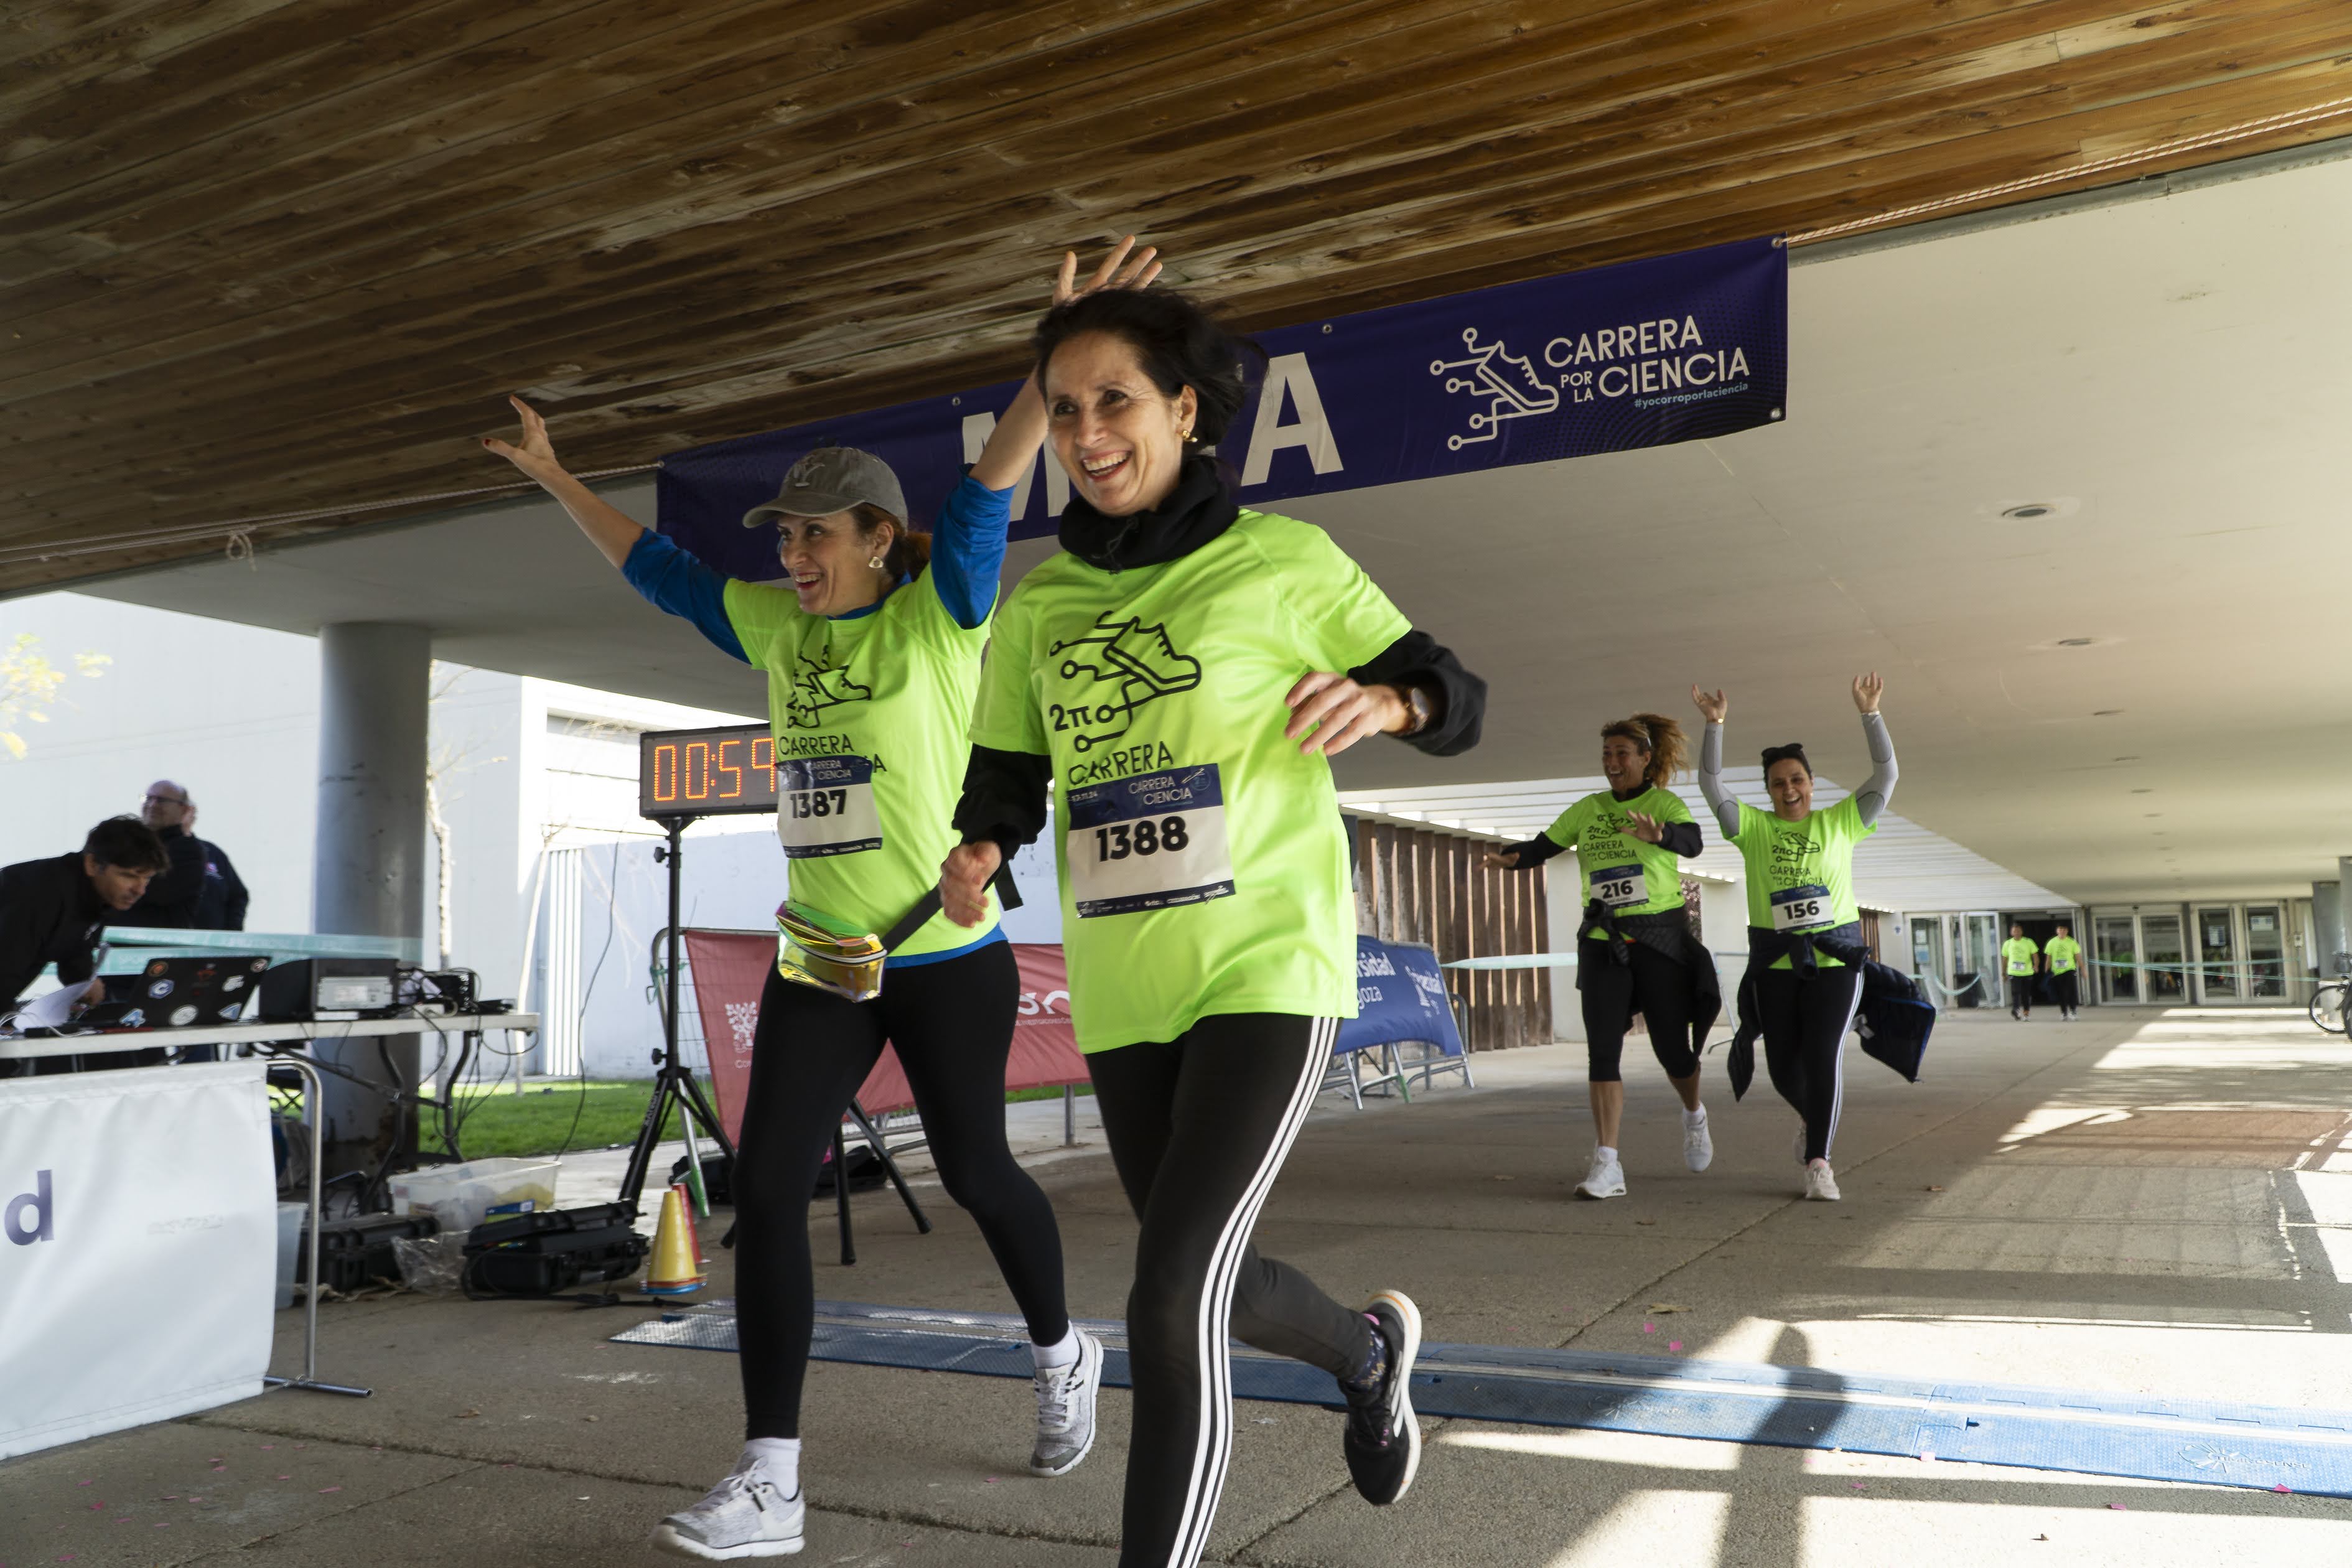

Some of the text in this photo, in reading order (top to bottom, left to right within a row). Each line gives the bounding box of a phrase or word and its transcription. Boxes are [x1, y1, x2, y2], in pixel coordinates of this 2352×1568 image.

[1544, 315, 1703, 368] CARRERA
[1561, 347, 1750, 398] POR CIENCIA
[1574, 387, 1594, 403] LA
[1634, 381, 1748, 409] #yocorroporlaciencia
[963, 352, 1344, 522] MA
[778, 734, 855, 755] CARRERA
[1068, 740, 1174, 786] CARRERA
[1128, 776, 1176, 795] CARRERA
[789, 788, 847, 819] 1387
[1142, 787, 1194, 805] CIENCIA
[1096, 815, 1189, 862] 1388
[1583, 840, 1625, 852] CARRERA
[1597, 849, 1638, 861] CIENCIA
[1769, 865, 1812, 878] CARRERA
[1600, 880, 1633, 899] 216
[1784, 900, 1820, 920] 156
